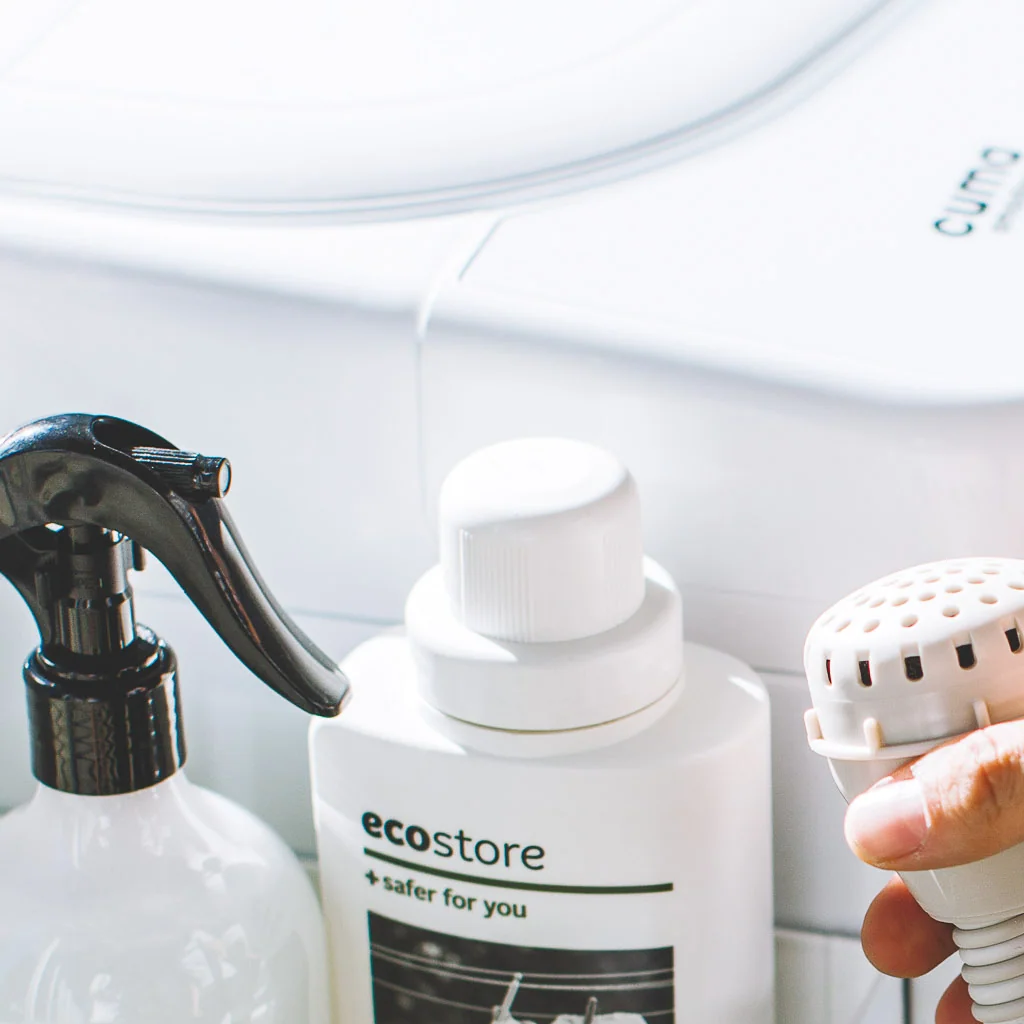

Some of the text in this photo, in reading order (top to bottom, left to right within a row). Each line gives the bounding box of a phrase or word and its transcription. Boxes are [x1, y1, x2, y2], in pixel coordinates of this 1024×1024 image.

[934, 146, 1021, 237] cuma
[361, 811, 545, 870] ecostore
[383, 875, 437, 903] safer
[443, 887, 477, 911] for
[484, 899, 527, 919] you
